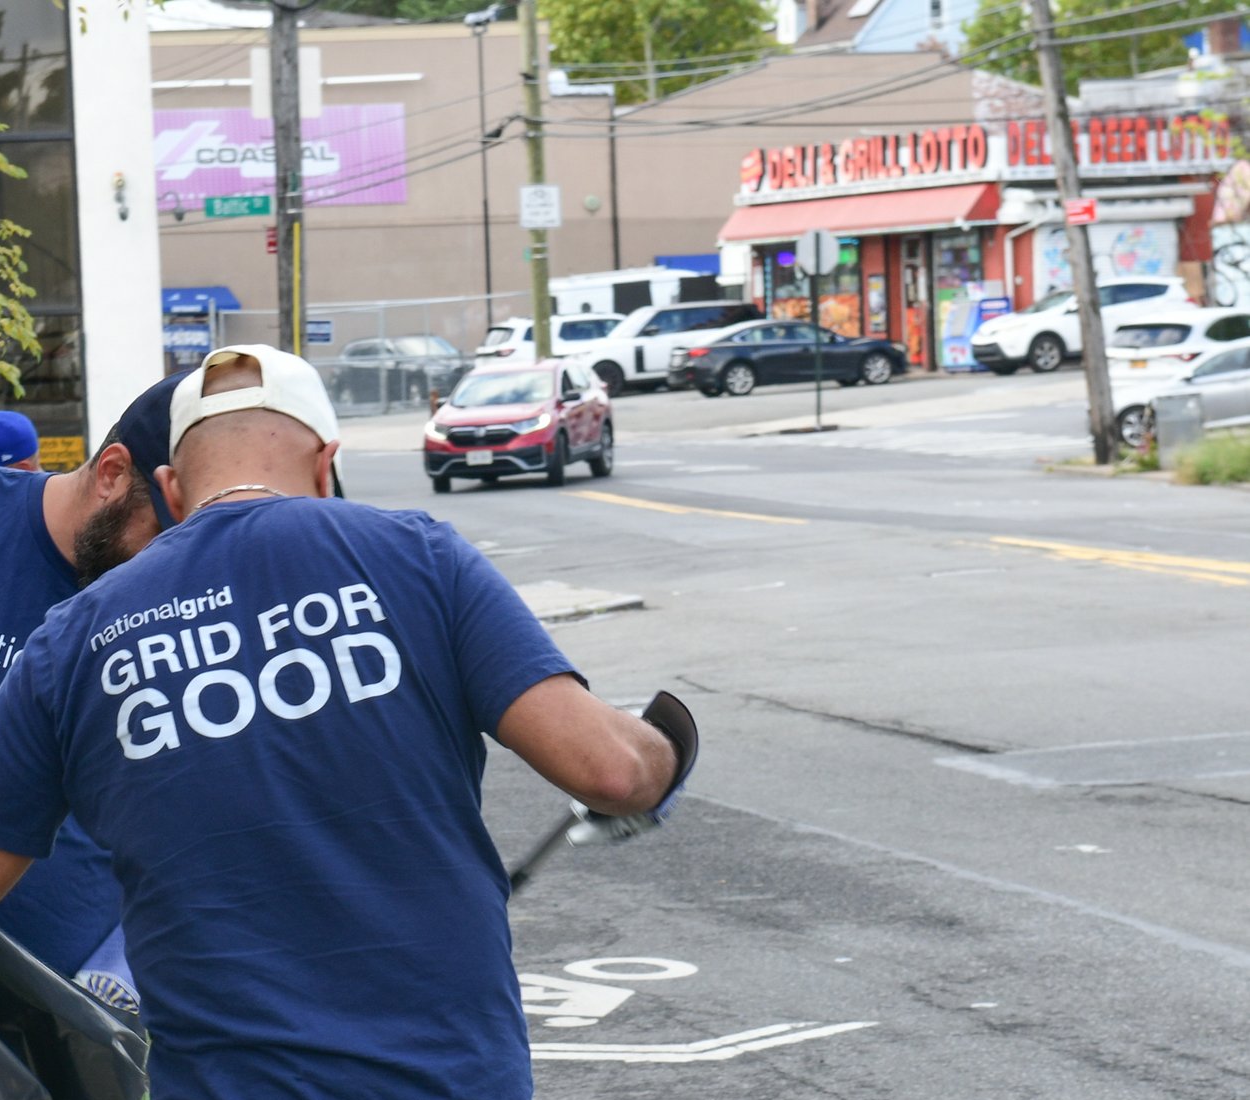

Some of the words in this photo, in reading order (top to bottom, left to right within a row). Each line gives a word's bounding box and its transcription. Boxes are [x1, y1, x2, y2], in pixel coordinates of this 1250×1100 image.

[196, 146, 335, 164] COASAL
[767, 147, 817, 190] DELI
[820, 142, 838, 187] &
[839, 134, 905, 183] GRILL
[907, 122, 988, 175] LOTTO
[1089, 116, 1148, 164] BEER
[213, 197, 249, 215] Baltic
[90, 586, 233, 652] nationalgrid
[101, 621, 241, 695] GRID
[257, 583, 387, 651] FOR
[116, 632, 402, 760] GOOD
